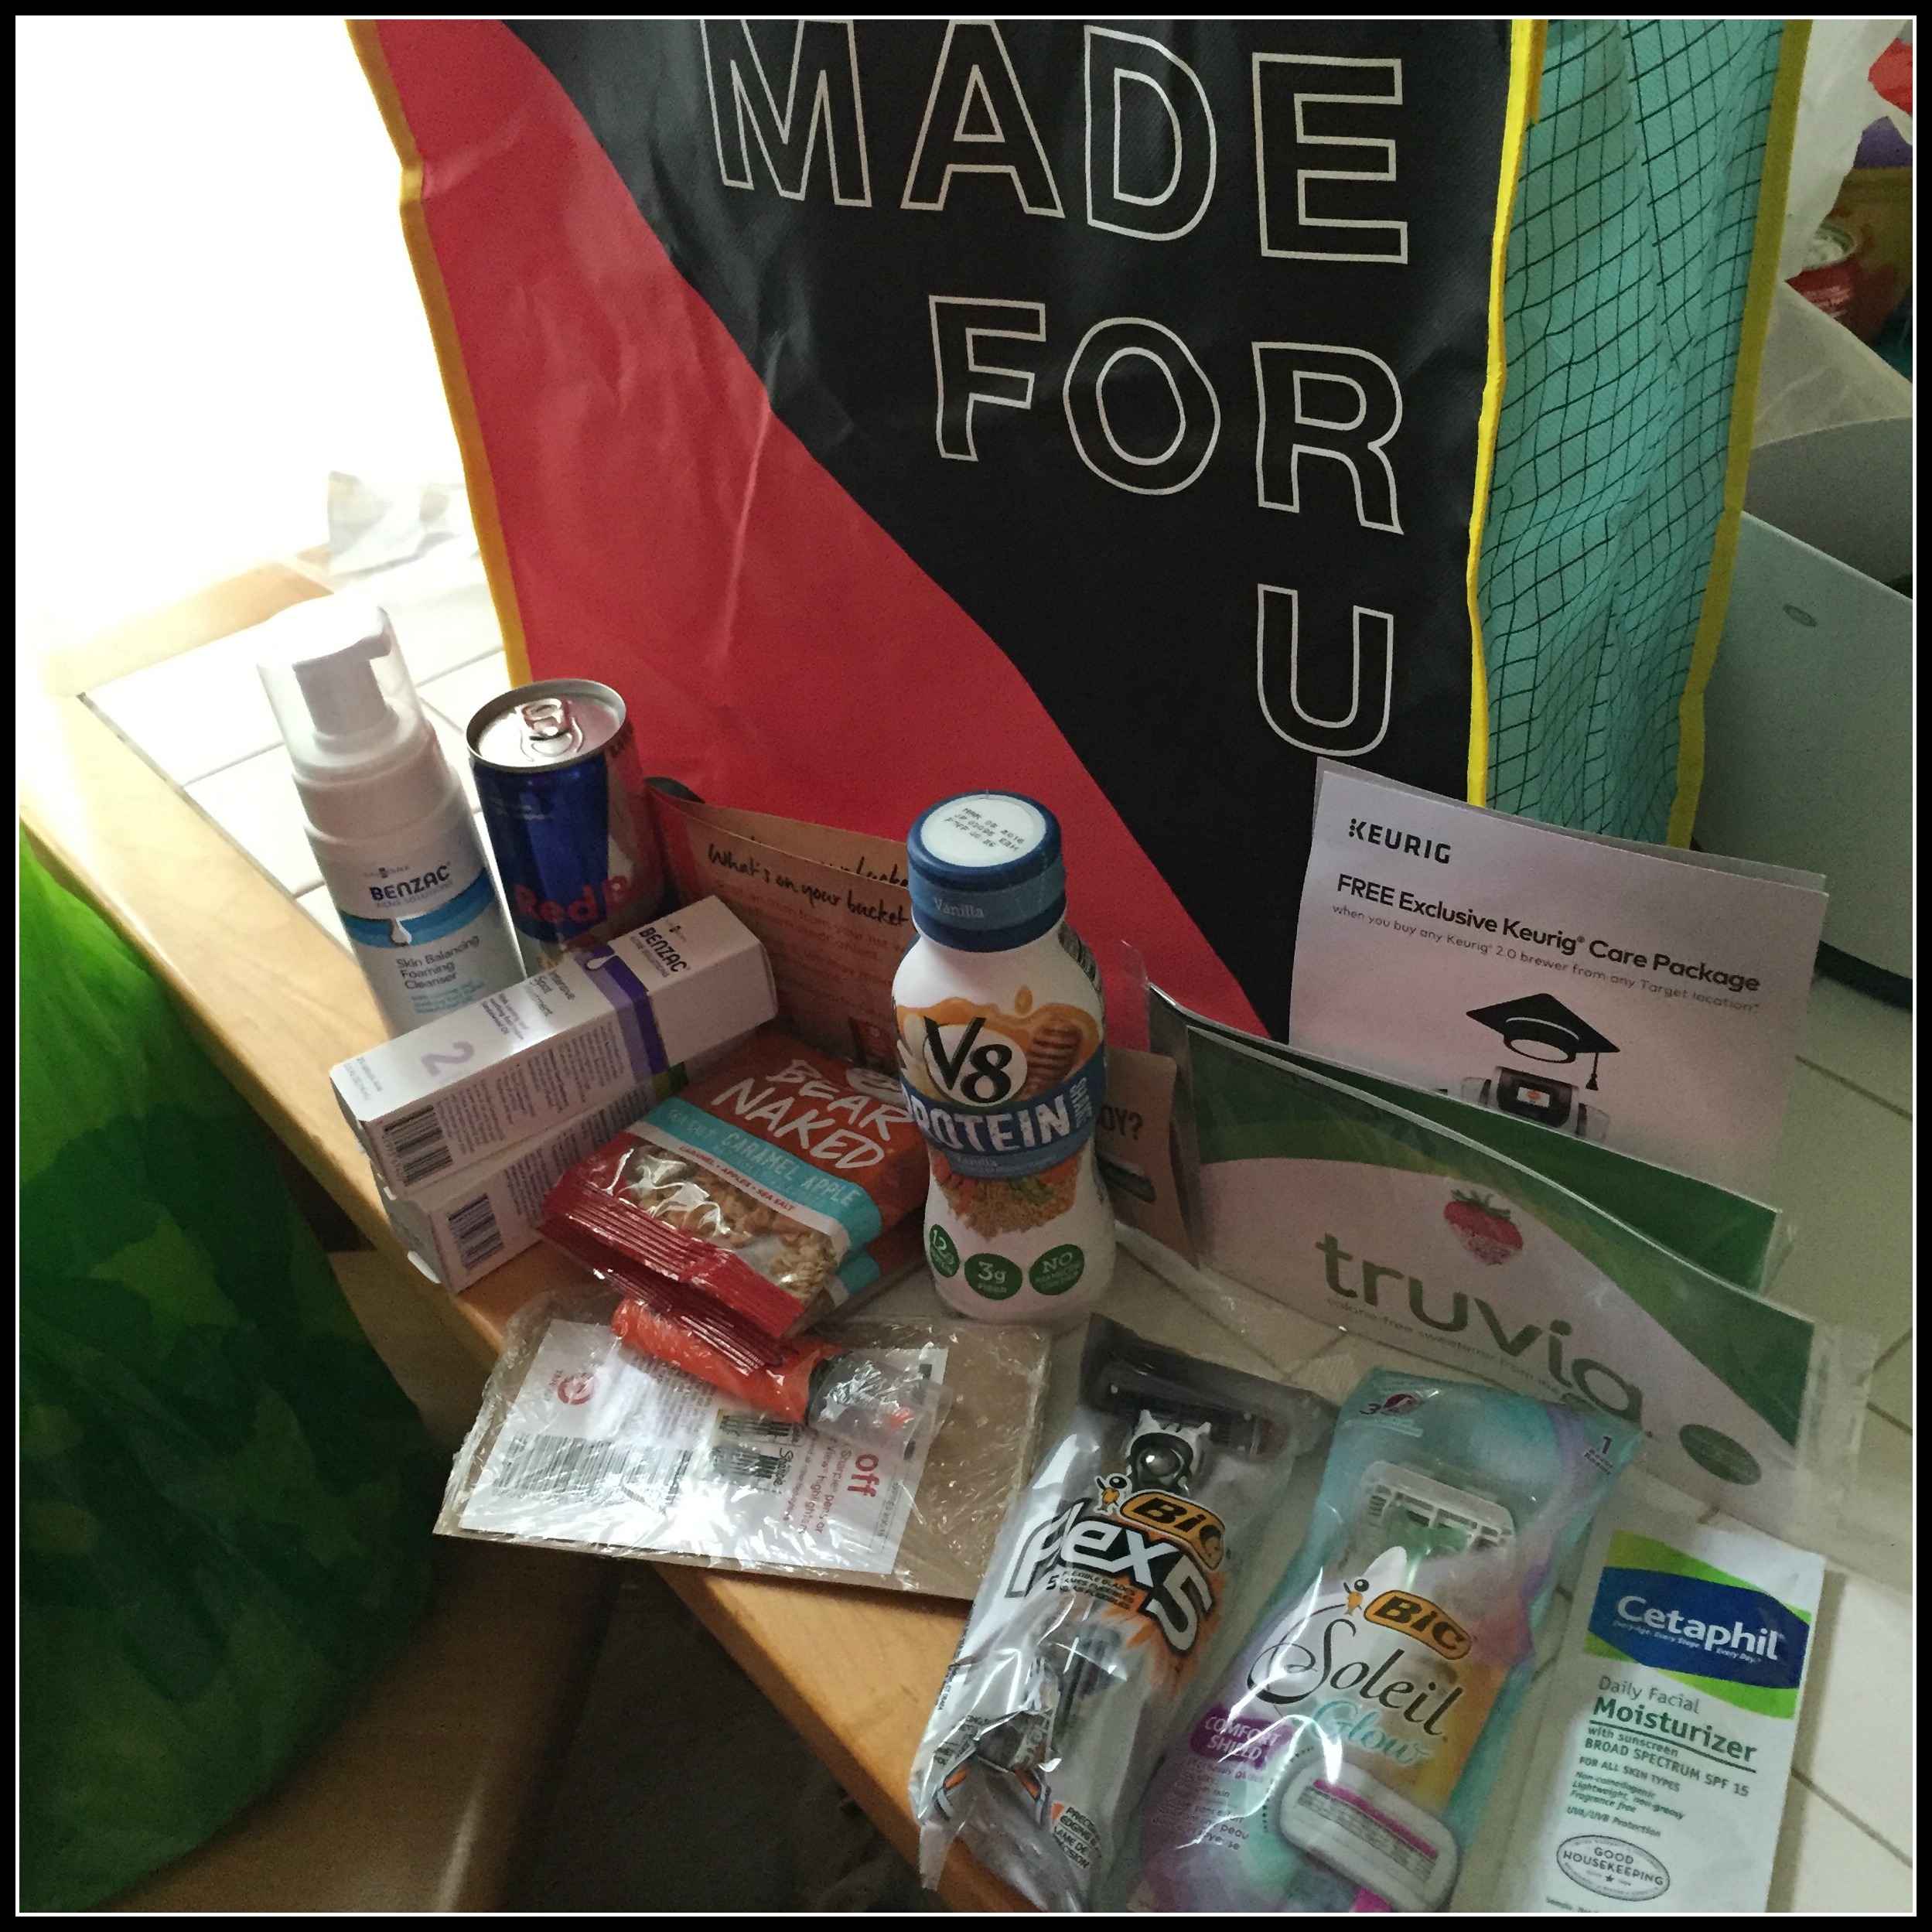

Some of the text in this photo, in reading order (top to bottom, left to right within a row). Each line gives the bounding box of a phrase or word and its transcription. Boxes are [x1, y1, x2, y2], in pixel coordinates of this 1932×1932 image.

[698, 19, 1408, 264] MADE
[928, 295, 1405, 534] FOR
[1257, 583, 1394, 756] U
[1349, 818, 1452, 865] KEURIG
[370, 865, 451, 901] BENZAC
[708, 843, 770, 884] What's
[776, 875, 799, 893] on
[801, 885, 842, 909] your
[846, 889, 910, 927] bucket
[934, 897, 985, 919] Vanilla
[424, 934, 480, 965] Balancing
[638, 927, 688, 972] BENZAC
[1332, 903, 1365, 921] when
[1368, 916, 1391, 930] you
[1393, 920, 1418, 937] buy
[1419, 929, 1442, 943] any
[1496, 945, 1517, 959] 2.0
[1521, 951, 1568, 971] brewer
[1572, 964, 1606, 981] from
[1610, 974, 1636, 989] any
[1640, 978, 1689, 998] Target
[1337, 873, 1395, 907] FREE
[1398, 890, 1498, 934] Exclusive
[1589, 940, 1647, 968] Care
[1653, 953, 1762, 993] Package
[400, 962, 456, 979] Foaming
[404, 971, 458, 989] Cleanser
[421, 1040, 475, 1077] 2
[923, 1015, 1013, 1104] V8
[765, 1058, 914, 1142] BEAR
[710, 1077, 885, 1169] NAKED
[721, 1133, 861, 1207] CARAMEL APPLE
[773, 1196, 795, 1212] SALT
[978, 1261, 1006, 1285] 3g
[1043, 1251, 1074, 1273] NO
[1316, 1233, 1645, 1426] truvia
[1602, 1435, 1613, 1454] 1
[847, 1453, 880, 1497] off
[814, 1522, 826, 1534] or
[1617, 1595, 1780, 1662] Cetaphil
[1247, 1616, 1463, 1736] Soleil
[1599, 1675, 1701, 1715] Daily Facial
[1204, 1715, 1282, 1746] COMFORT
[1207, 1734, 1262, 1761] SHIELD
[1312, 1699, 1429, 1765] Glow
[1588, 1725, 1679, 1759] with sunscreen
[1593, 1696, 1759, 1763] Moisturizer
[1579, 1756, 1681, 1793] FOR ALL SKIN TYPES
[1584, 1739, 1750, 1798] BROAD SPECTRUM SPF 15
[1562, 1849, 1664, 1886] HOUSEKEEPING
[1594, 1846, 1634, 1865] GOOD
